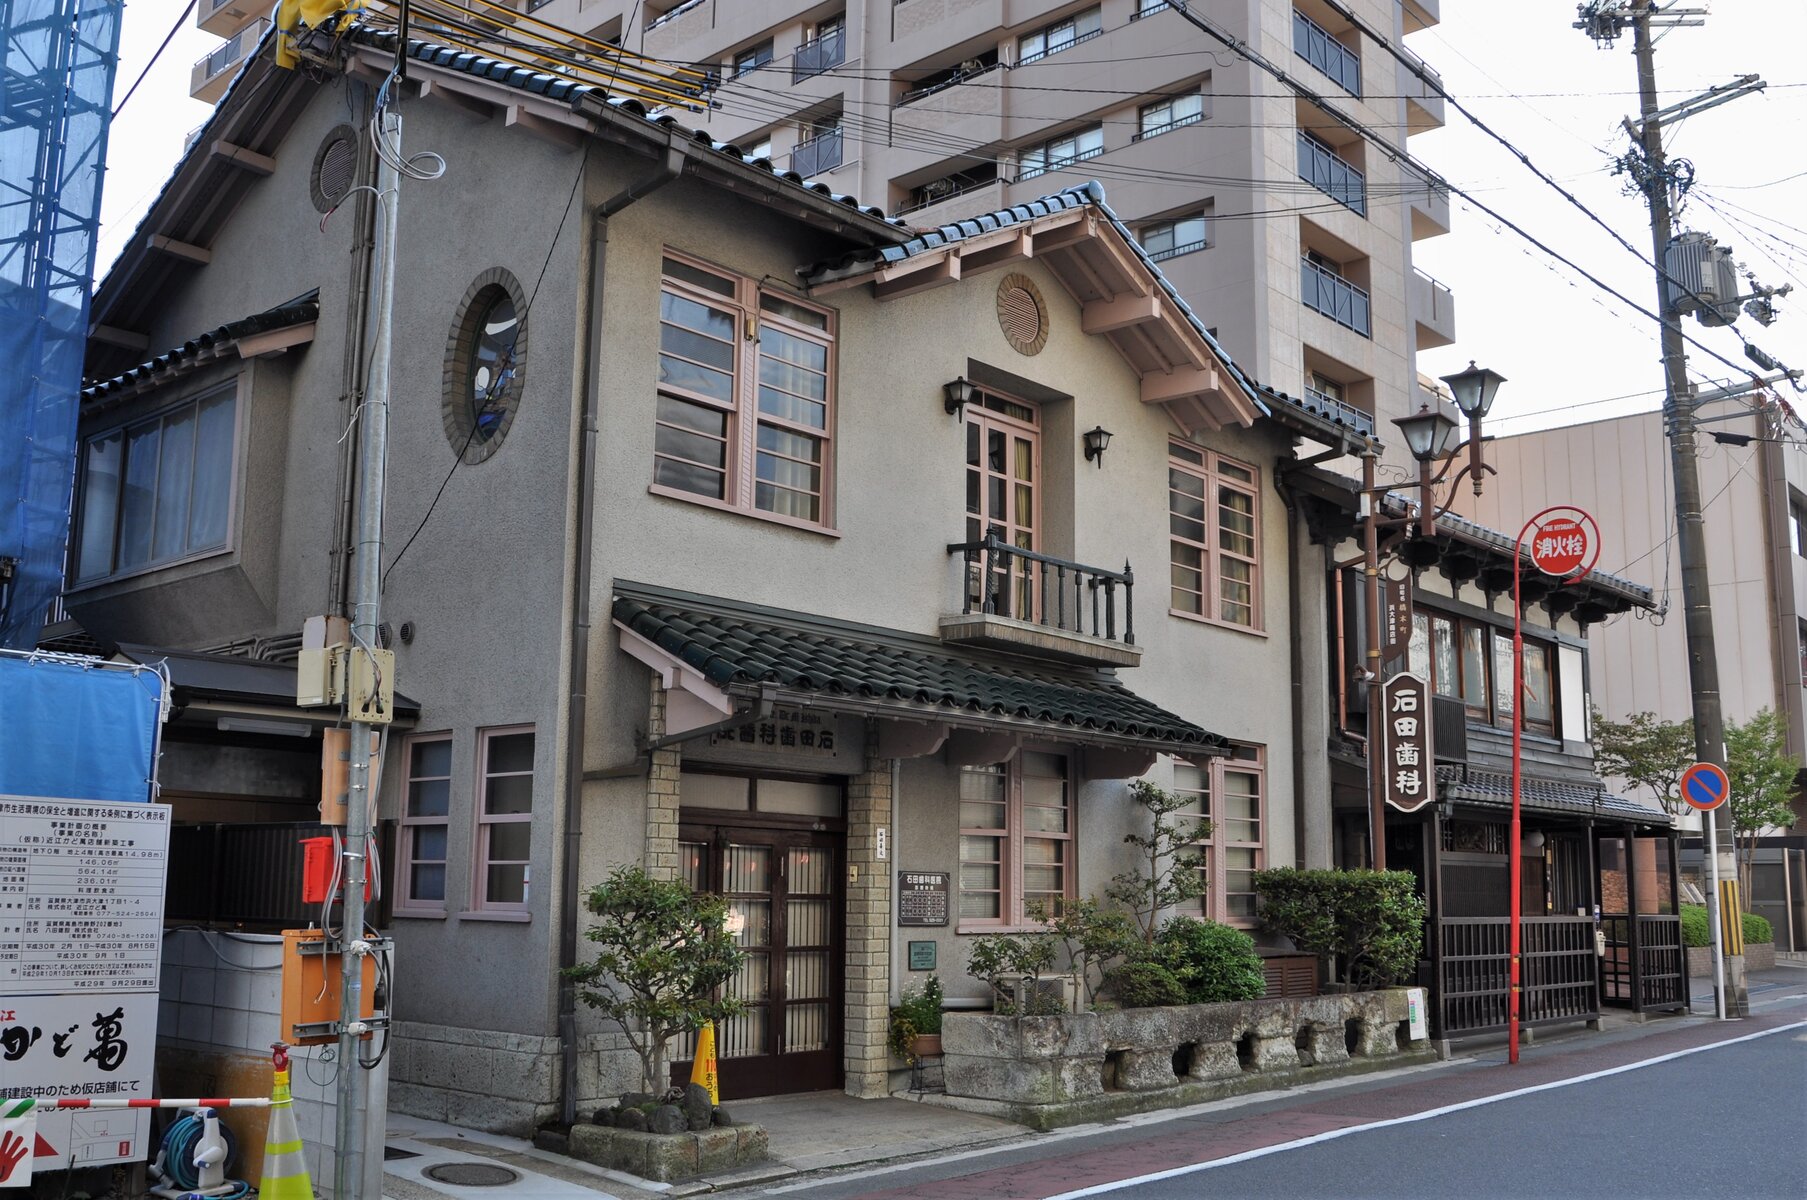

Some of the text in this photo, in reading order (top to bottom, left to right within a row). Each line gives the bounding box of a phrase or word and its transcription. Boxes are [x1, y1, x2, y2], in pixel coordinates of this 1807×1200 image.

[1536, 534, 1583, 559] 消火栓
[1392, 689, 1422, 795] 石田歯科
[0, 1006, 128, 1071] かど萬
